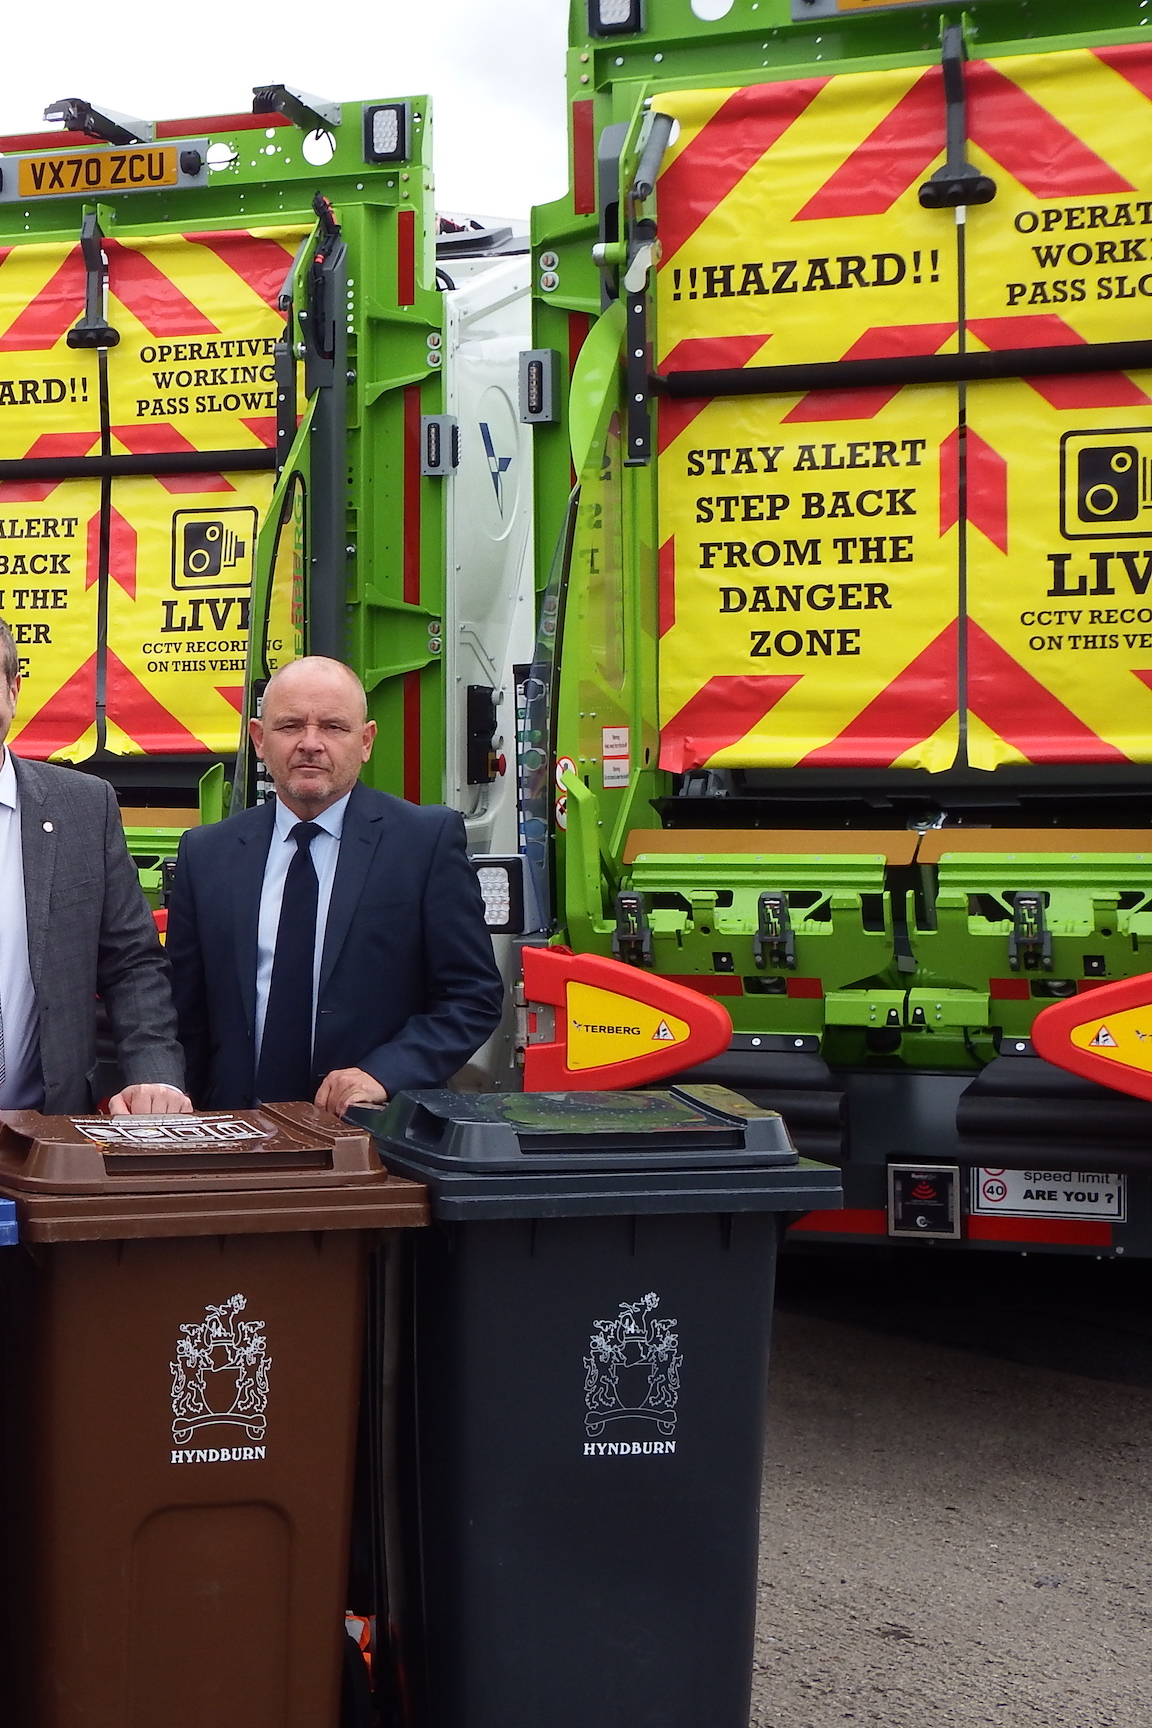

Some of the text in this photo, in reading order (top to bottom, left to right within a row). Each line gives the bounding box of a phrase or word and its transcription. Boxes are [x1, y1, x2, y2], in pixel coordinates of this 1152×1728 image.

[30, 152, 164, 190] VX70 ZCU
[1014, 201, 1152, 234] OPERAT
[1032, 237, 1152, 269] WORK
[673, 249, 939, 301] !!HAZARD!!
[1006, 278, 1087, 306] PASS
[139, 337, 285, 364] OPERATIVE
[153, 365, 276, 389] WORKING
[136, 391, 278, 417] PASS SLOWL
[687, 439, 926, 477] STAY ALERT
[696, 488, 917, 523] STEP BACK
[699, 535, 914, 569] FROM THE
[12, 589, 68, 609] THE
[719, 582, 892, 613] DANGER
[1020, 608, 1152, 626] CCTV RECO
[142, 641, 181, 654] CCTV
[750, 628, 861, 657] ZONE
[1029, 635, 1064, 651] ON
[1068, 634, 1119, 650] THIS
[147, 658, 279, 672] ON THIS VEHIE
[583, 1024, 641, 1036] TERBERG
[1023, 1171, 1110, 1184] speed limit
[986, 1185, 1004, 1196] 40
[1023, 1189, 1058, 1201] ARE
[1063, 1191, 1099, 1203] YOU
[170, 1445, 267, 1464] HYNDBURN
[583, 1440, 677, 1456] HYNDBURN
